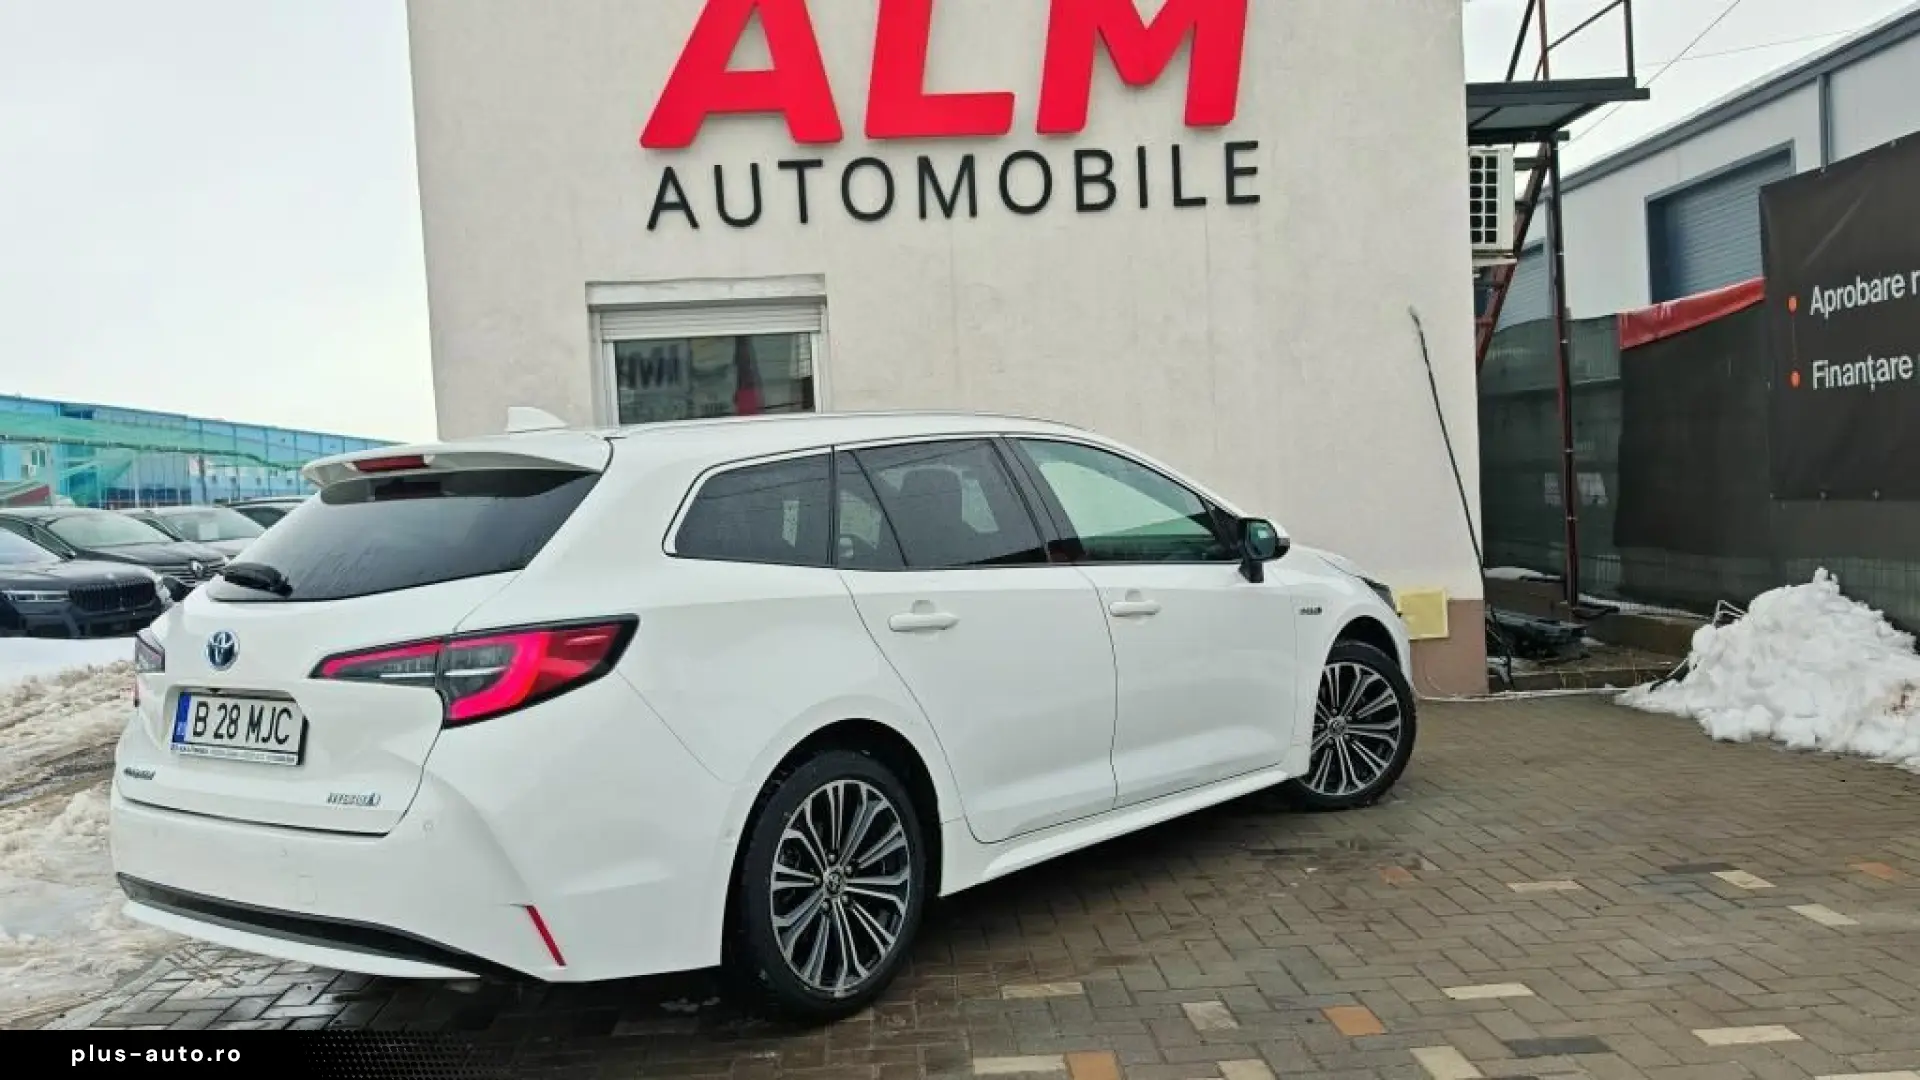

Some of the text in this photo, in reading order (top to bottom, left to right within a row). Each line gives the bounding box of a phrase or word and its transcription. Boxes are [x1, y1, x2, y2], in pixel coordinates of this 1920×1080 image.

[642, 0, 1247, 147] ALM
[646, 140, 1261, 232] AUTOMOBILE
[1809, 273, 1907, 319] Aprobare
[1811, 353, 1914, 391] Finanțare
[192, 700, 293, 745] B 28 MJC
